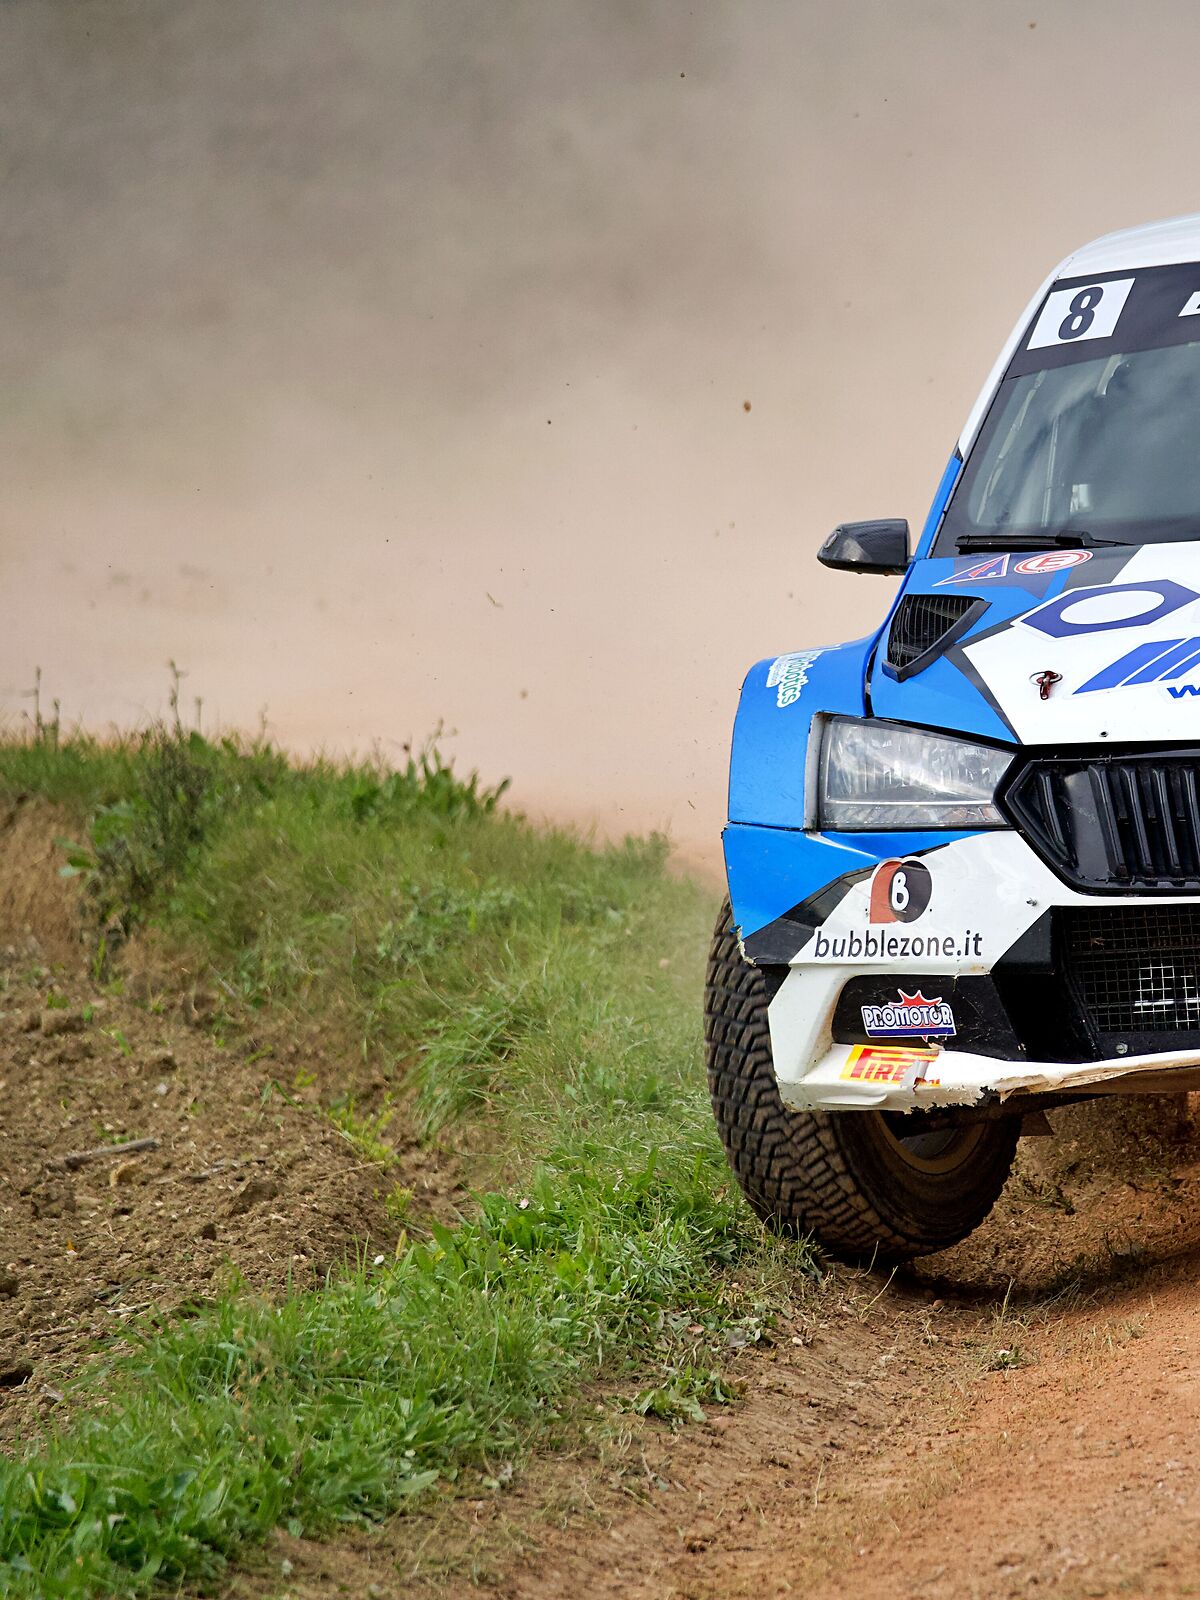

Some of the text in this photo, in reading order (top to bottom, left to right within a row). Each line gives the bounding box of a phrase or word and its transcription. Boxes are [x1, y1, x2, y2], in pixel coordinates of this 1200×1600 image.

[1058, 286, 1104, 340] 8
[814, 929, 983, 958] bubblezone.it
[863, 1005, 953, 1028] PROMOTOR
[850, 1048, 940, 1084] PIRE
